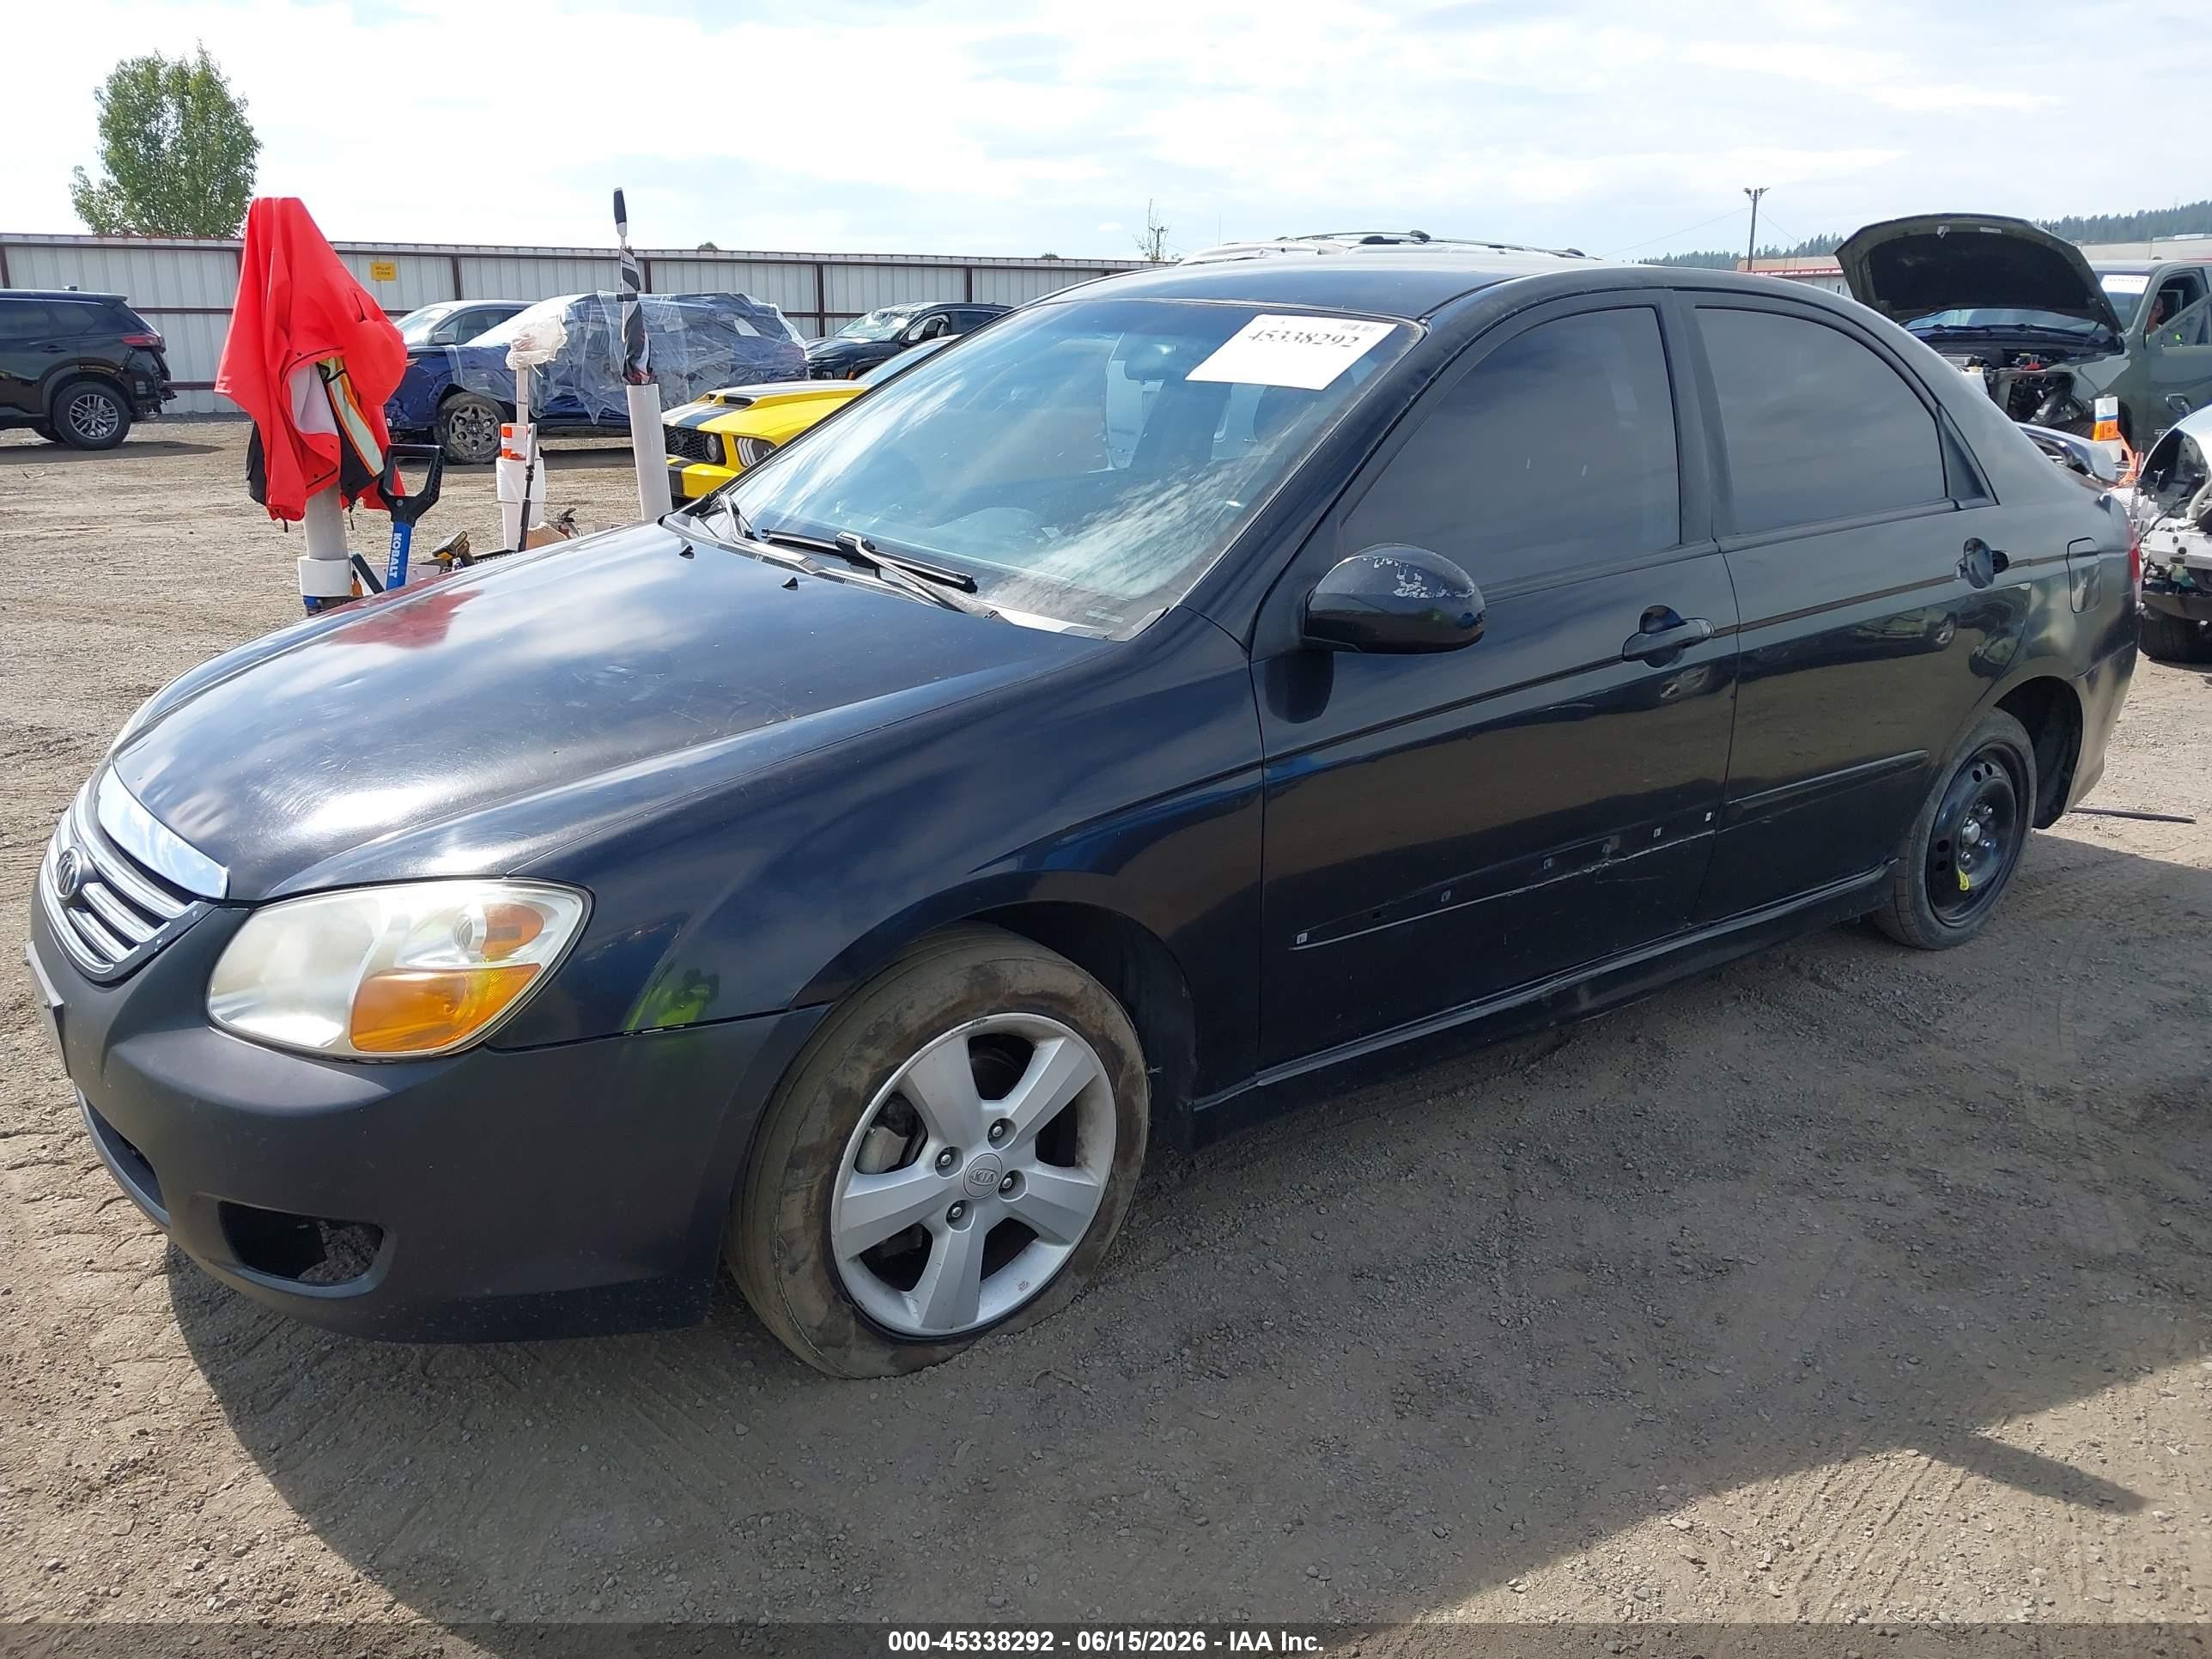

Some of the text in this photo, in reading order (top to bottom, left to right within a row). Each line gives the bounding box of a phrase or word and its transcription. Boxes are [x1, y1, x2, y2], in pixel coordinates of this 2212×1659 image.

[1248, 330, 1360, 347] 45338292
[389, 532, 403, 579] KOBALT
[971, 1170, 995, 1182] KIA
